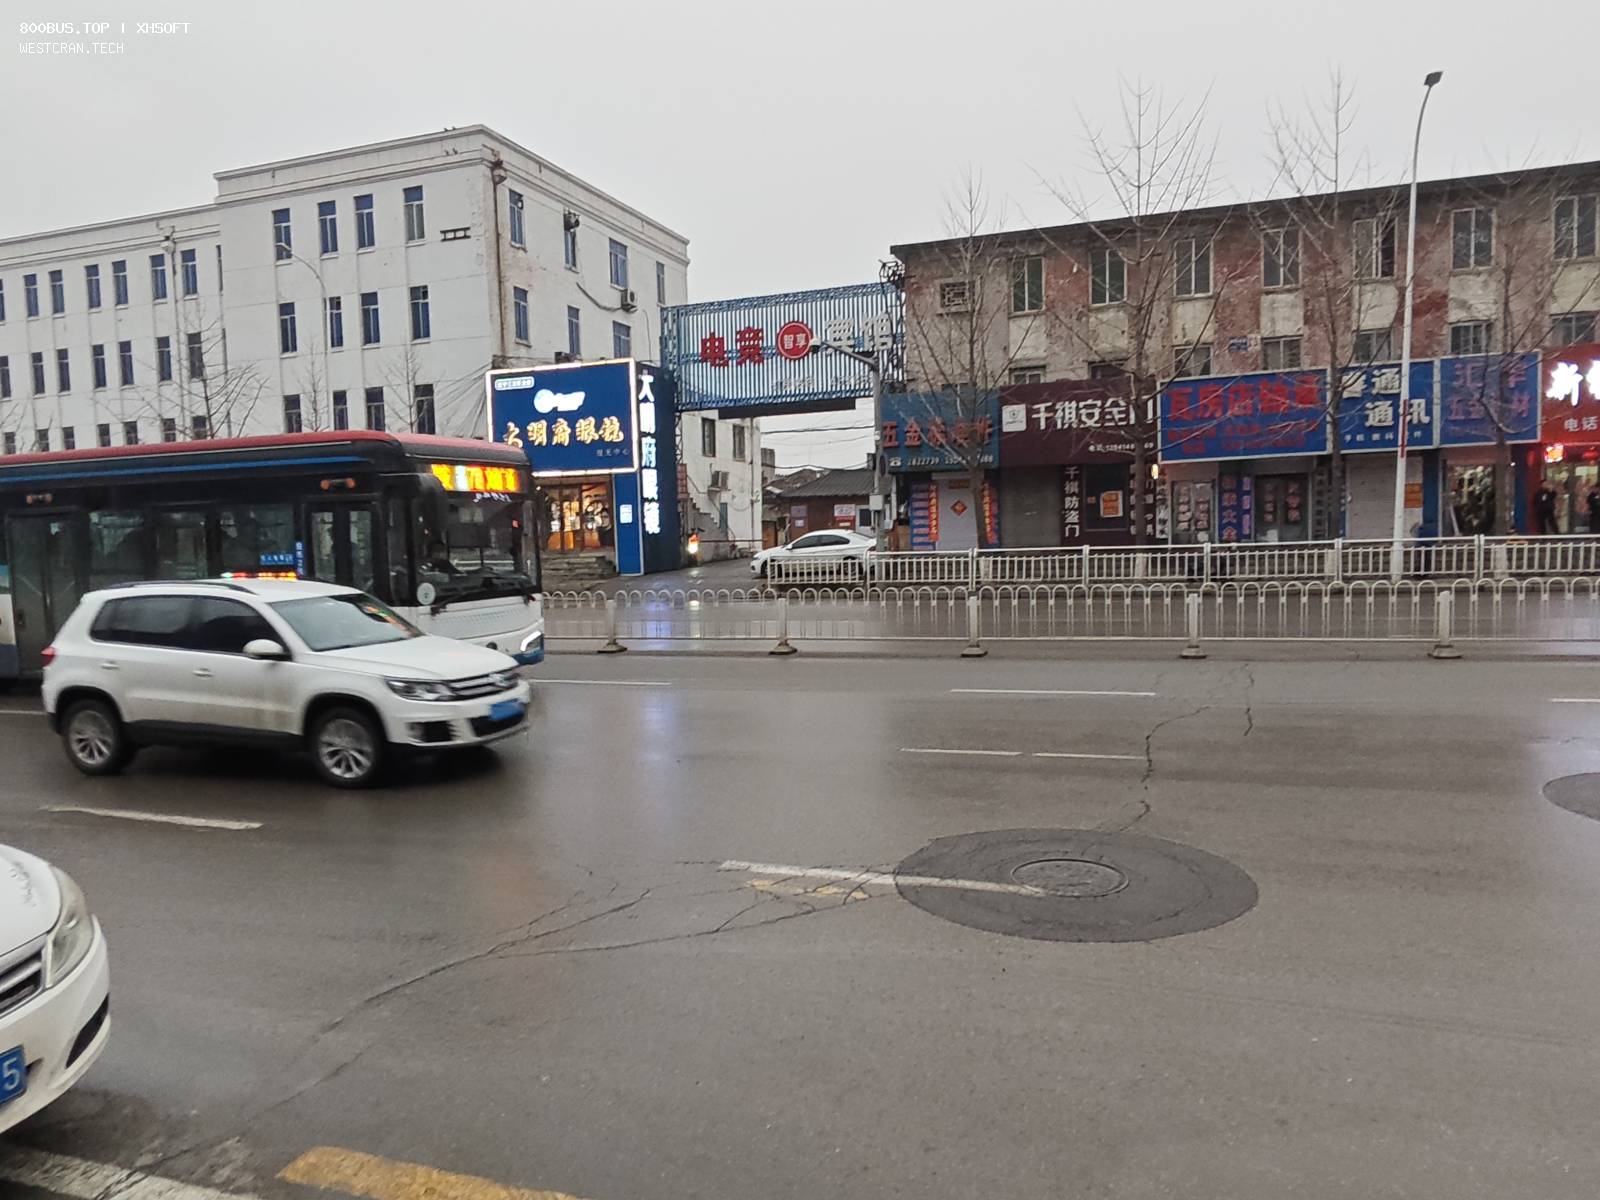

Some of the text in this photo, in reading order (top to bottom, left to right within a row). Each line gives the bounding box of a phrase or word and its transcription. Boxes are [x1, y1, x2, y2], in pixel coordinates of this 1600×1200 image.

[1064, 467, 1080, 538] 千祺防盗门
